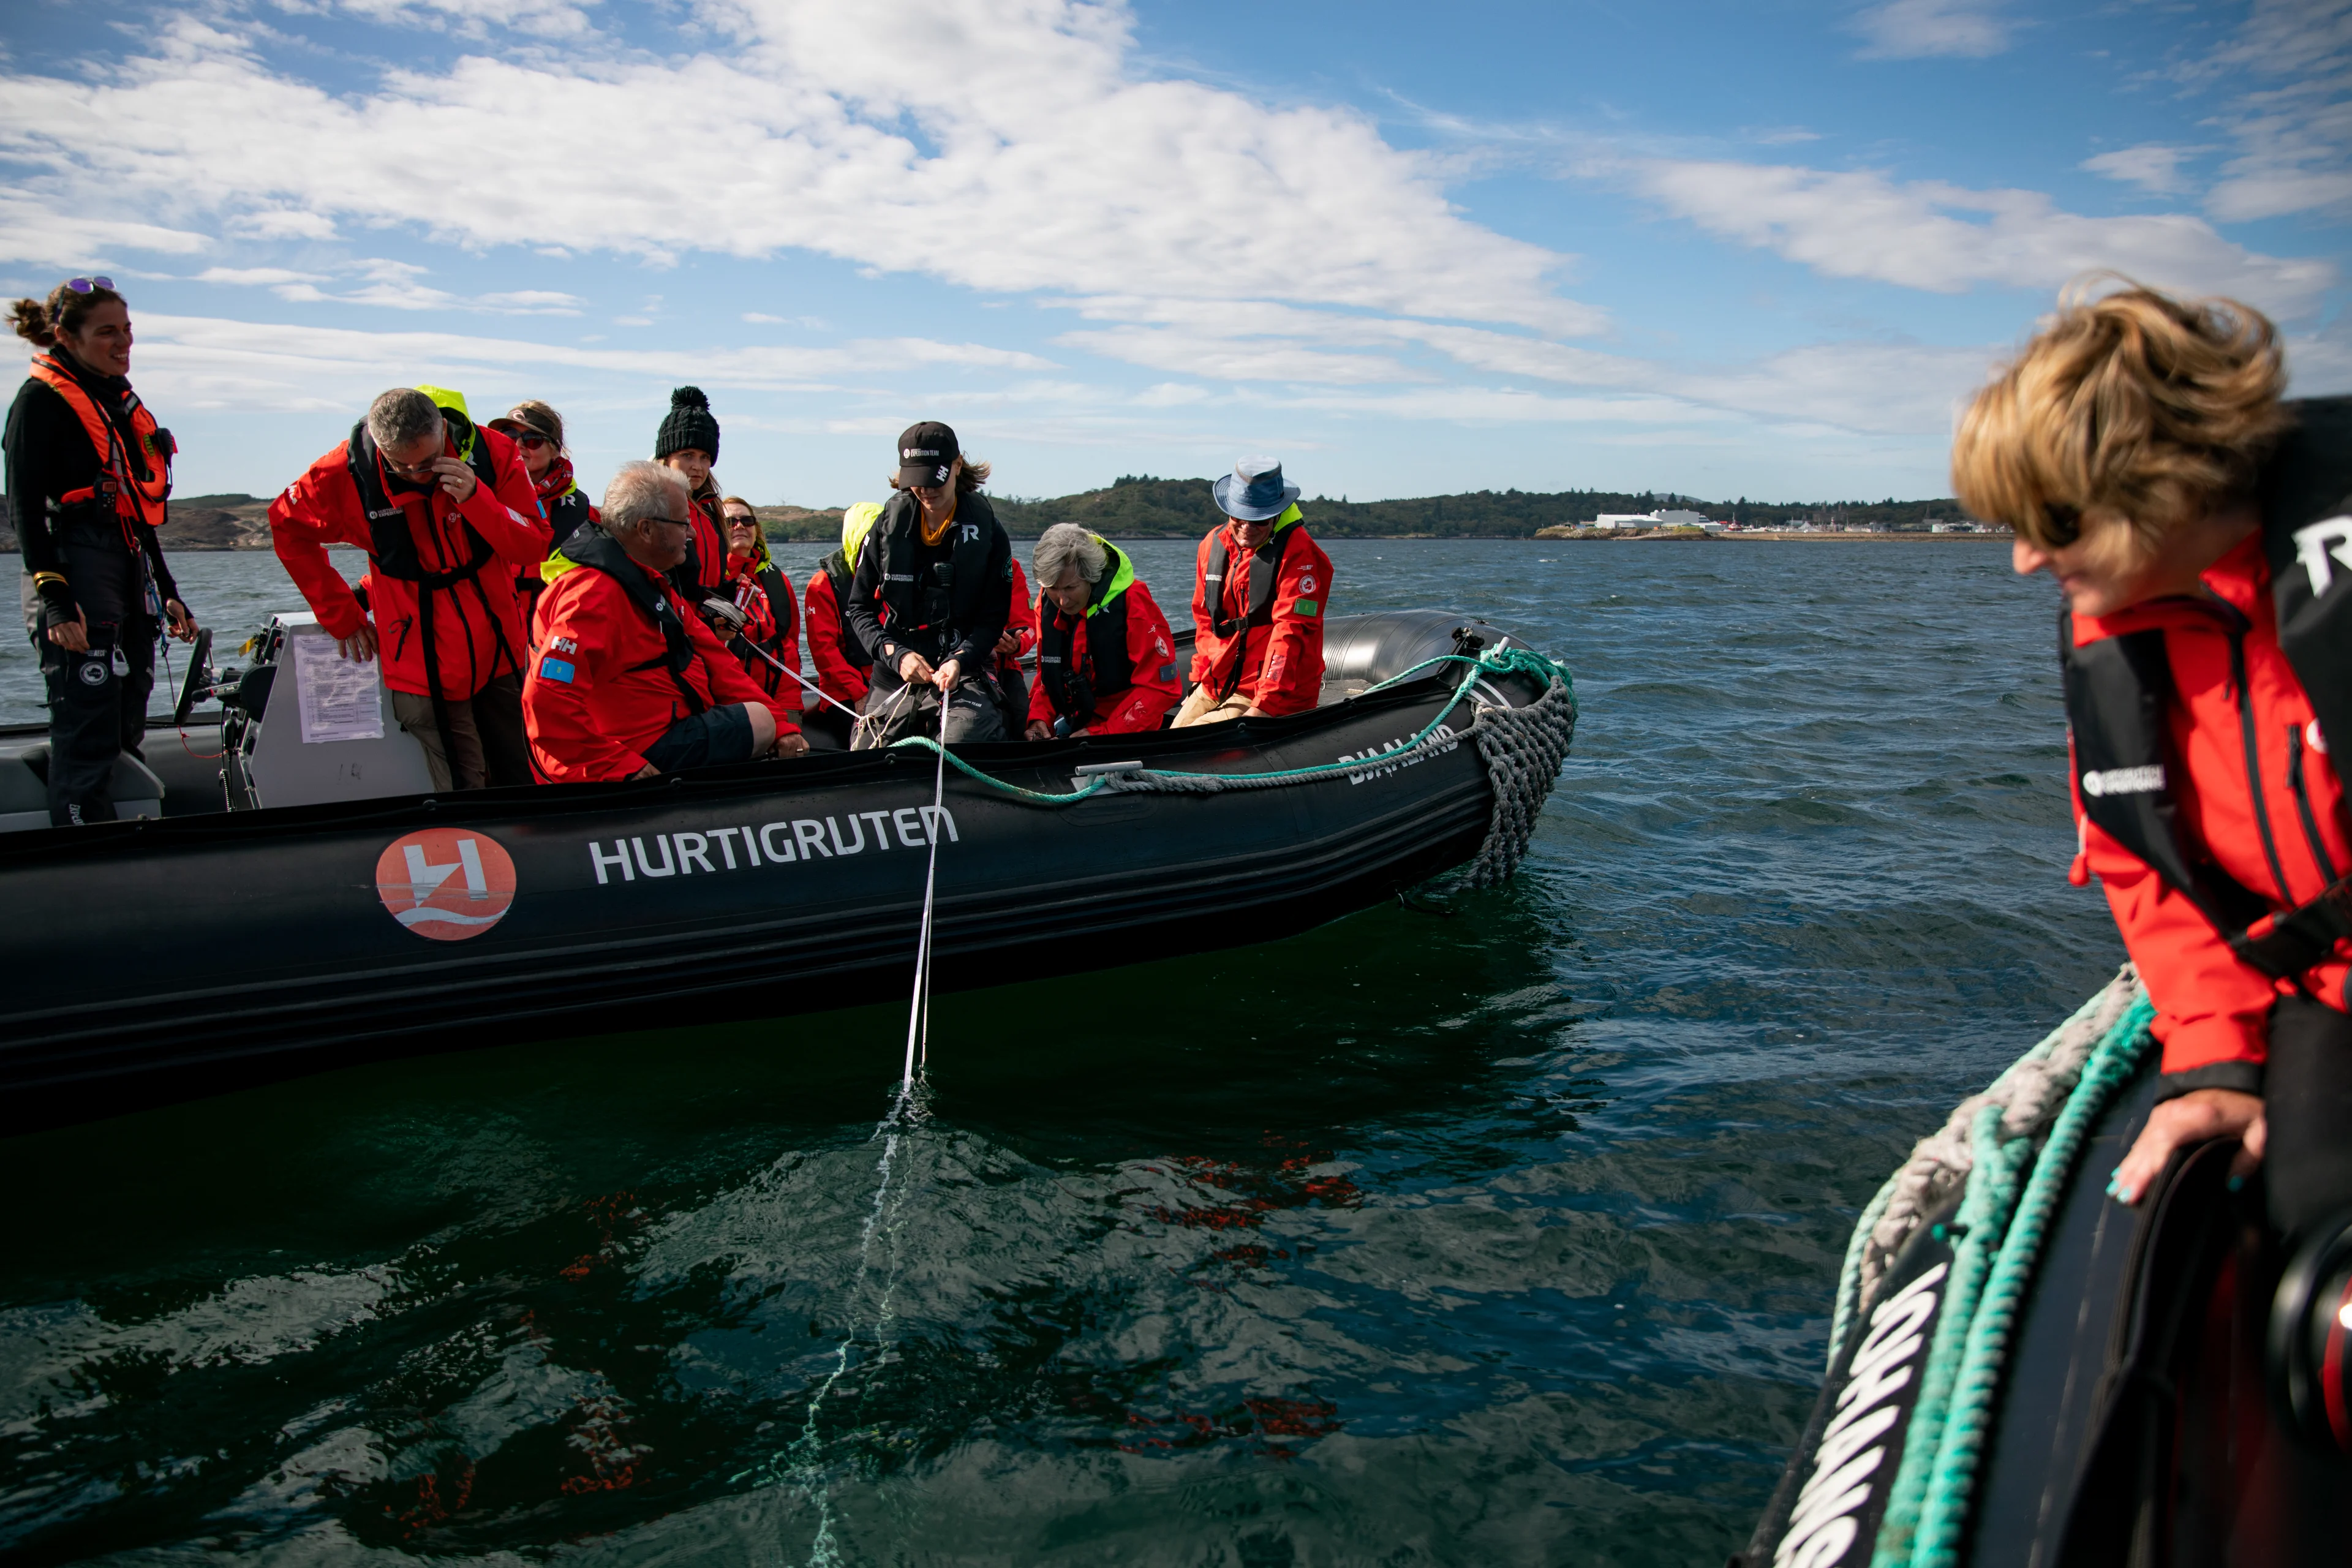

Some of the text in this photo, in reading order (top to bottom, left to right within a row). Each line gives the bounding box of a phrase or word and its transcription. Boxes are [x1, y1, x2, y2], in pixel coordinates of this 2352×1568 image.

[936, 465, 949, 483] HH
[551, 636, 578, 655] HH
[589, 805, 959, 884] HURTIGRUTEN
